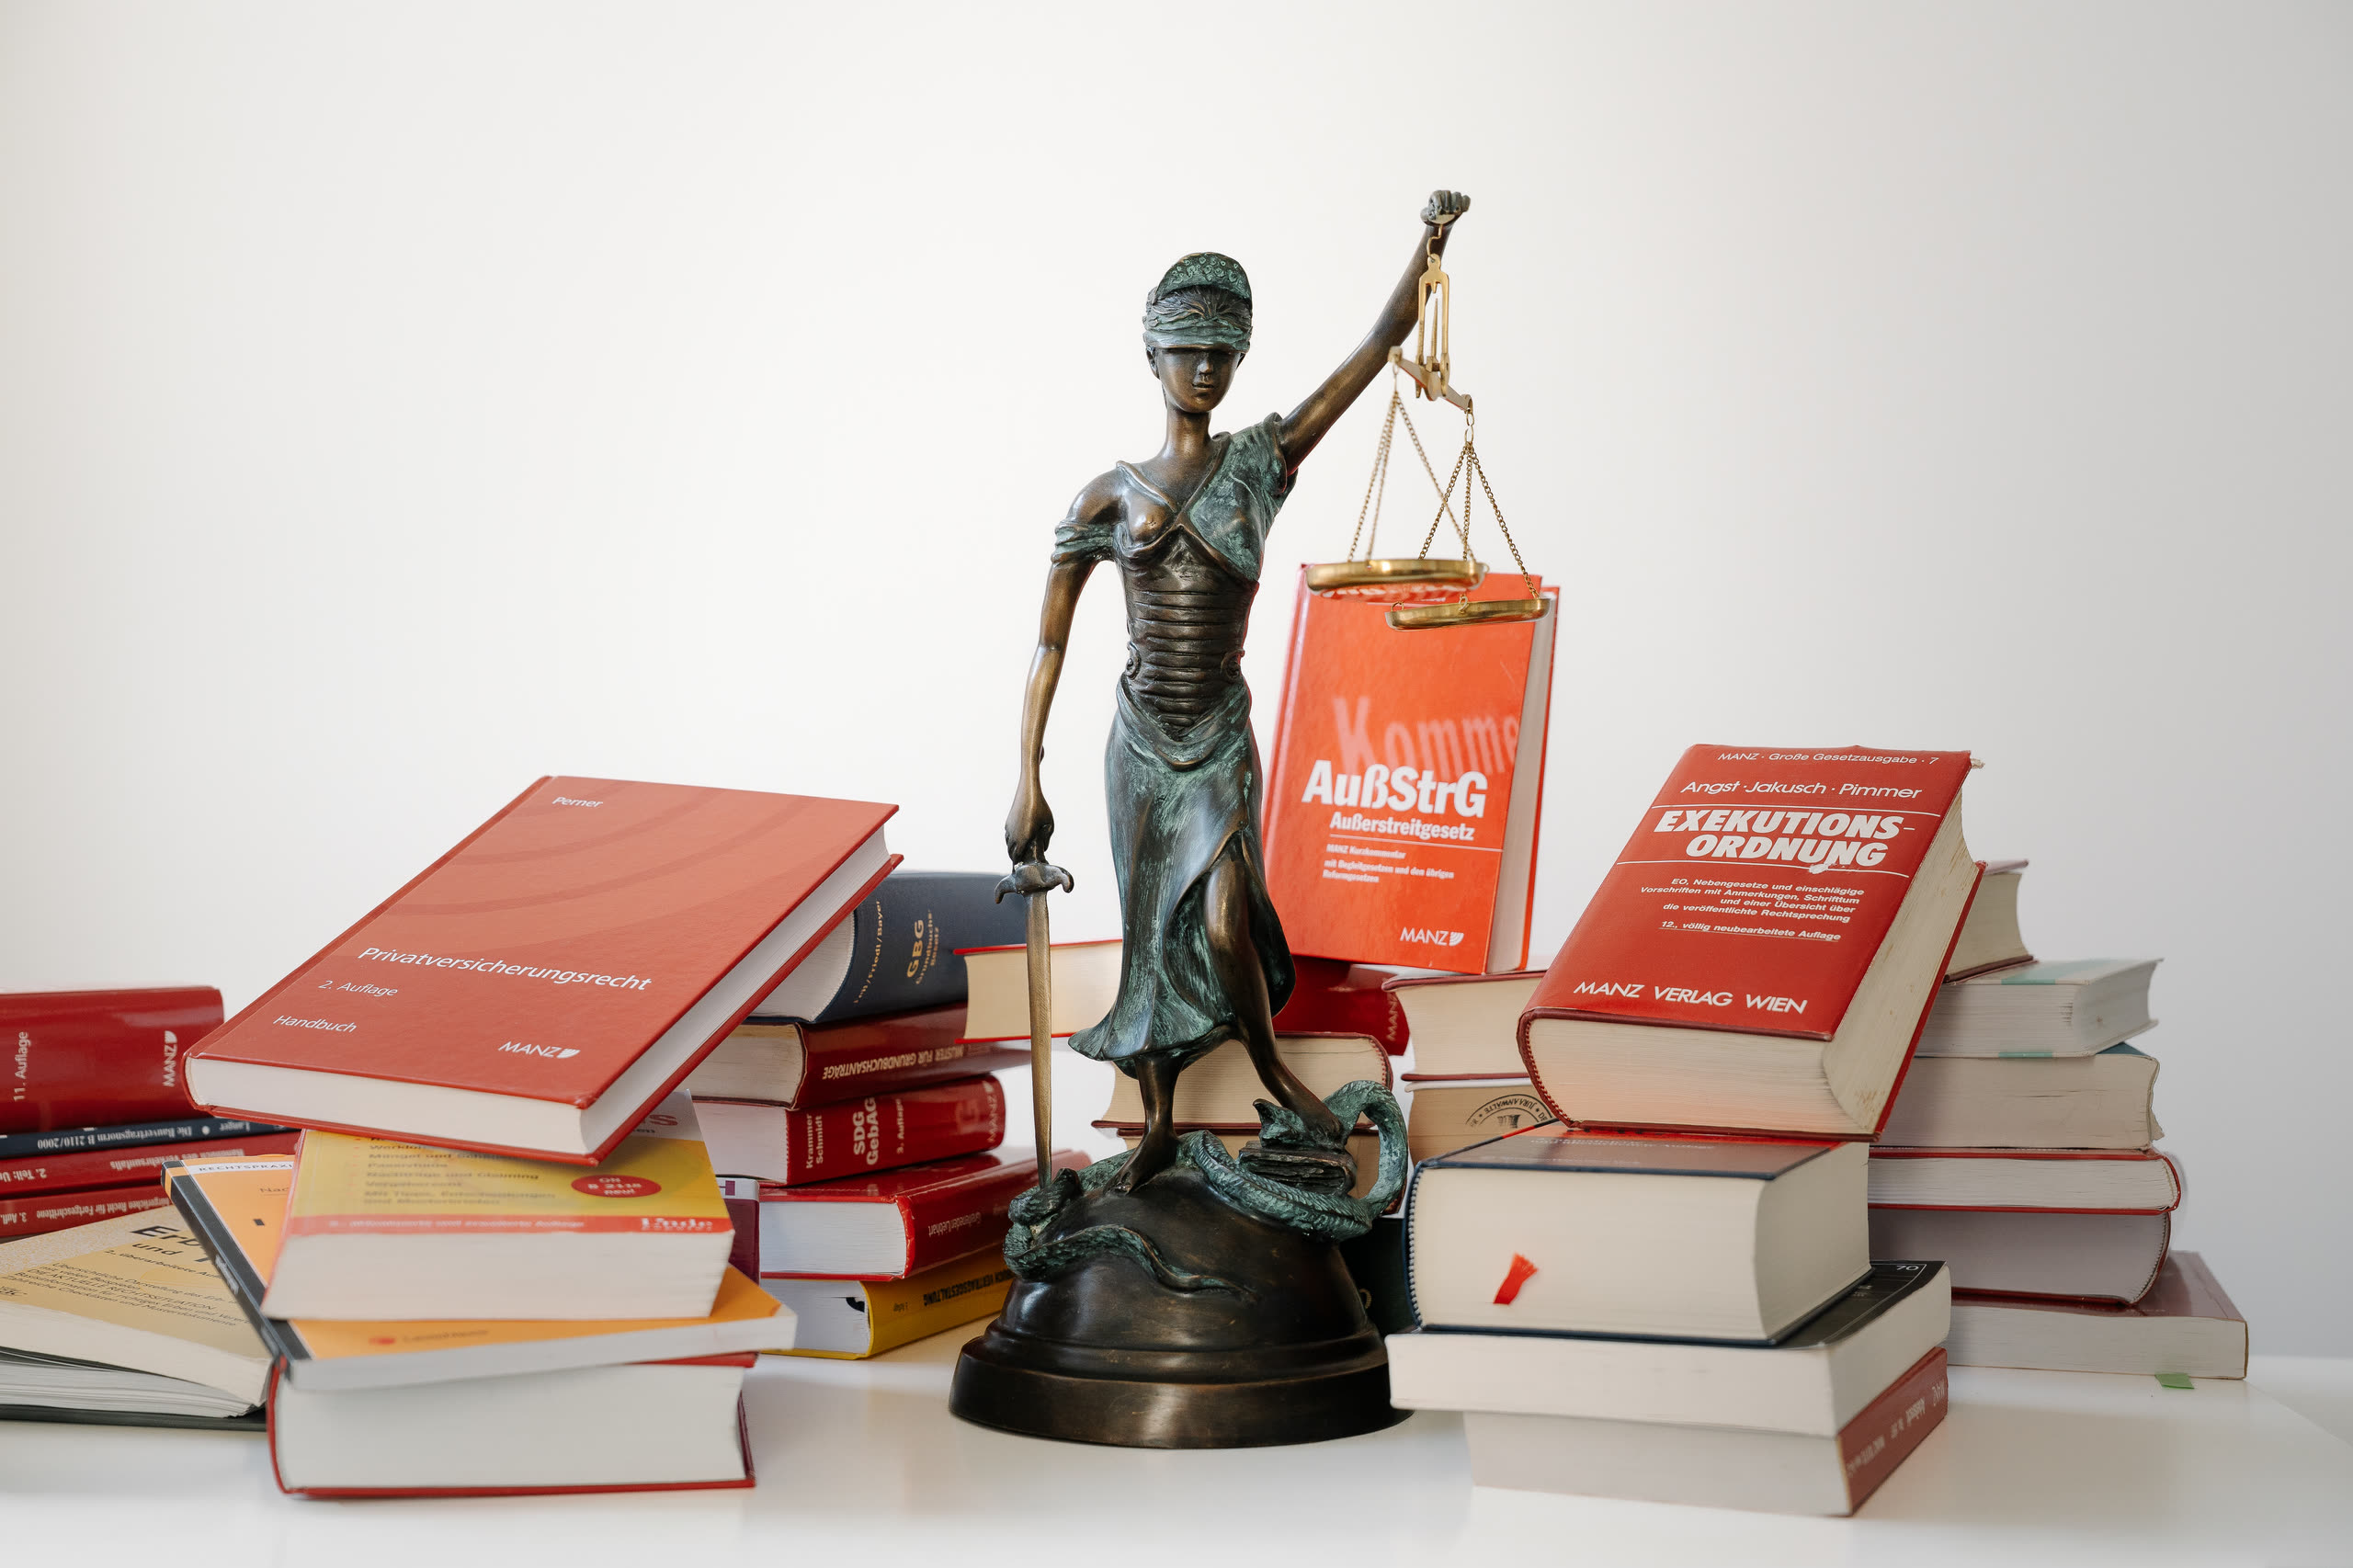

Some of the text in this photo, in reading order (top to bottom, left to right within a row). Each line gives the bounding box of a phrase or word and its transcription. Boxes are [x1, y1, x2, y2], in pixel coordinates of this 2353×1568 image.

[1718, 753, 1938, 765] MANZ Große Gesetzausgabe 7
[1301, 759, 1488, 818] AußStrG
[1680, 780, 1923, 799] Angst Jakusch Pimmer
[551, 796, 604, 808] Perner
[1329, 811, 1475, 841] Außerstreitgesetz
[1654, 810, 1915, 840] EXEKUTIONS-
[1685, 834, 1889, 867] ORDNUNG
[1324, 859, 1337, 869] mit
[1395, 866, 1410, 875] und
[1641, 886, 1860, 904] Vorschriften mit Anmerkungen, Schrifttum
[1671, 878, 1865, 896] EO, Nebengesetze und einschlägige
[1663, 903, 1851, 924] die veröffentlichte Rechtsprechung
[1721, 897, 1857, 914] und einer Übersicht über
[1400, 926, 1449, 946] MANZ
[1682, 921, 1711, 932] völlig
[1713, 924, 1795, 937] neubearbeitete
[1798, 929, 1841, 941] Auflage
[906, 919, 924, 978] GBG
[358, 948, 653, 992] Privatversicherungsrecht
[317, 980, 399, 998] 2. Auflage
[1573, 982, 1808, 1014] MANZ VERLAG WIEN
[273, 1015, 358, 1033] Handbuch
[15, 1031, 31, 1080] Auflage
[498, 1040, 559, 1058] MANZ
[917, 1050, 934, 1066] FÜR
[163, 1043, 178, 1087] MANZ
[822, 1052, 916, 1080] GRUNDBUCHSANTRÄGE
[87, 1135, 96, 1145] B
[97, 1126, 175, 1142] Bauvertragsnorm
[177, 1126, 192, 1136] Die
[815, 1115, 824, 1165] Schmidt
[852, 1111, 866, 1155] SDG
[864, 1097, 880, 1165] GebAG
[37, 1136, 85, 1149] 2110/2000
[805, 1113, 813, 1169] Krammer
[36, 1168, 47, 1177] 2.
[131, 1243, 184, 1256] und
